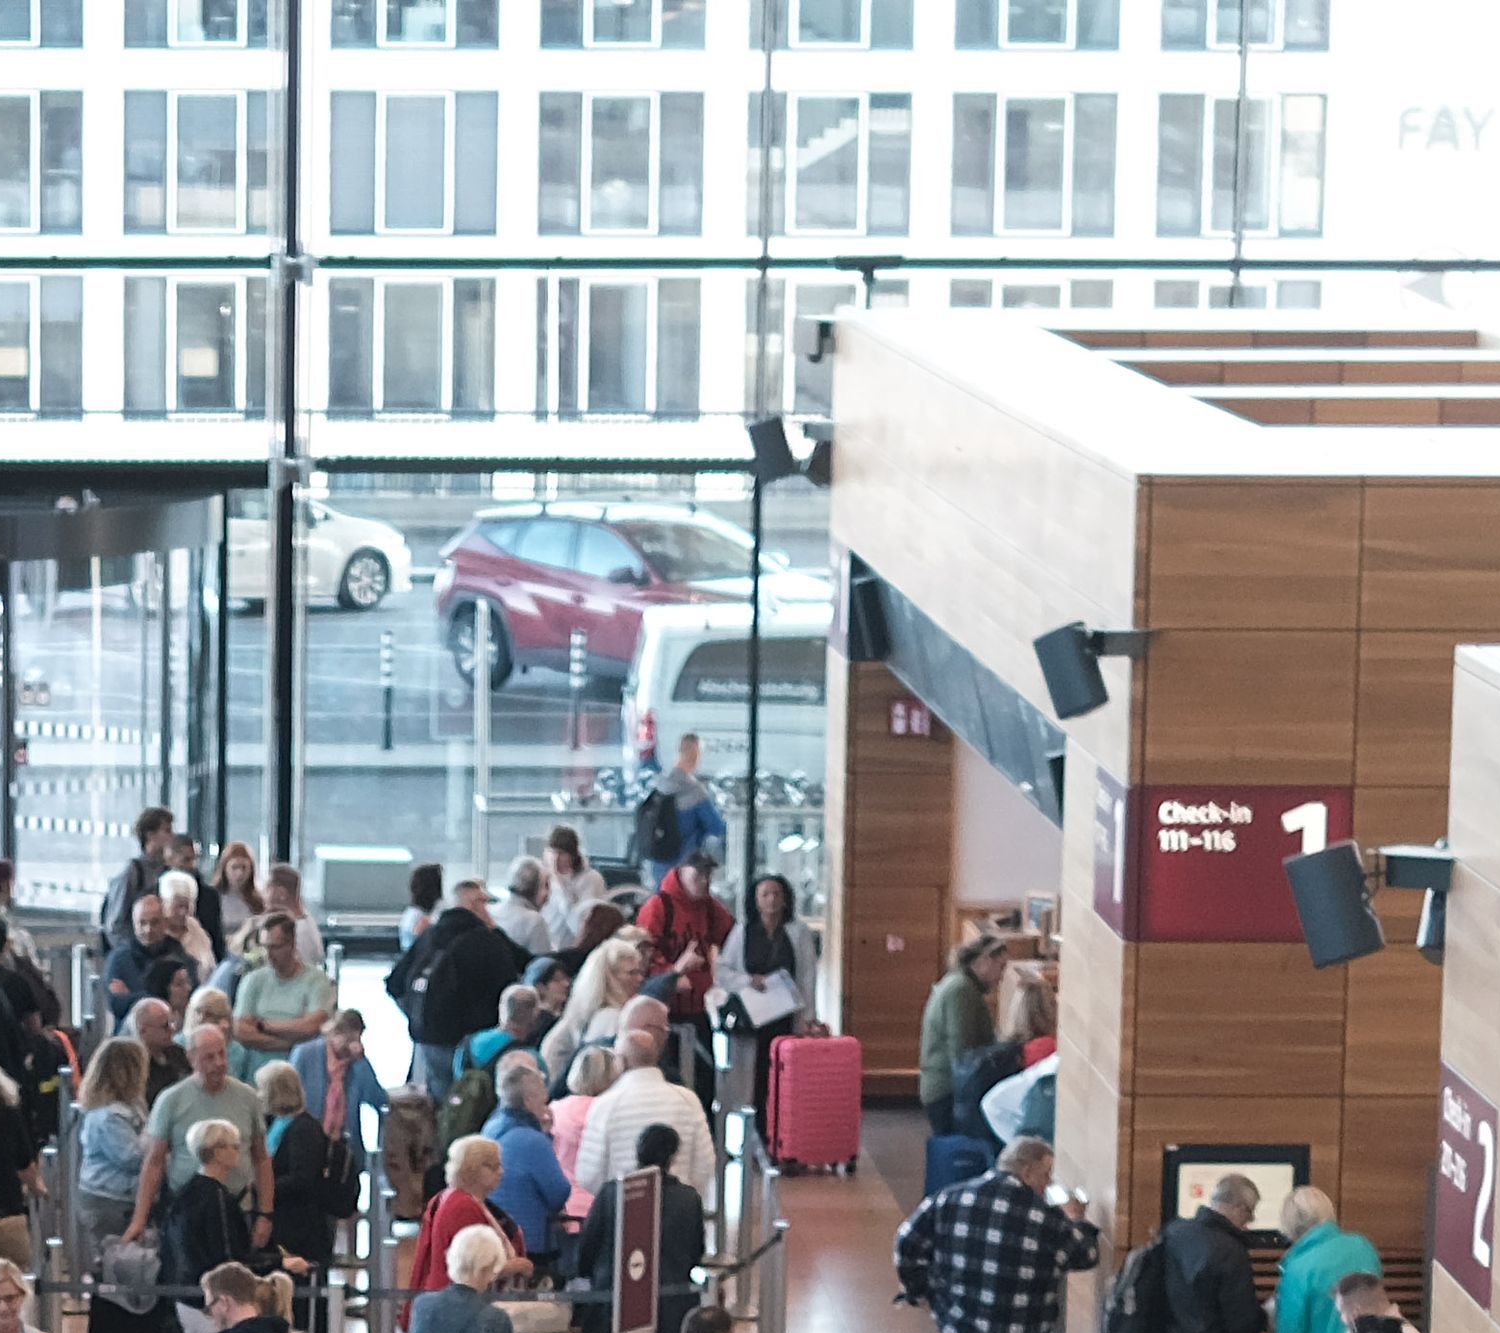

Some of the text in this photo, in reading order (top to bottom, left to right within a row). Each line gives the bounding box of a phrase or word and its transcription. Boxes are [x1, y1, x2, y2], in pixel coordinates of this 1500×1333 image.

[1399, 107, 1493, 151] FAY
[1158, 801, 1252, 825] Check-in
[1472, 1120, 1494, 1268] 2
